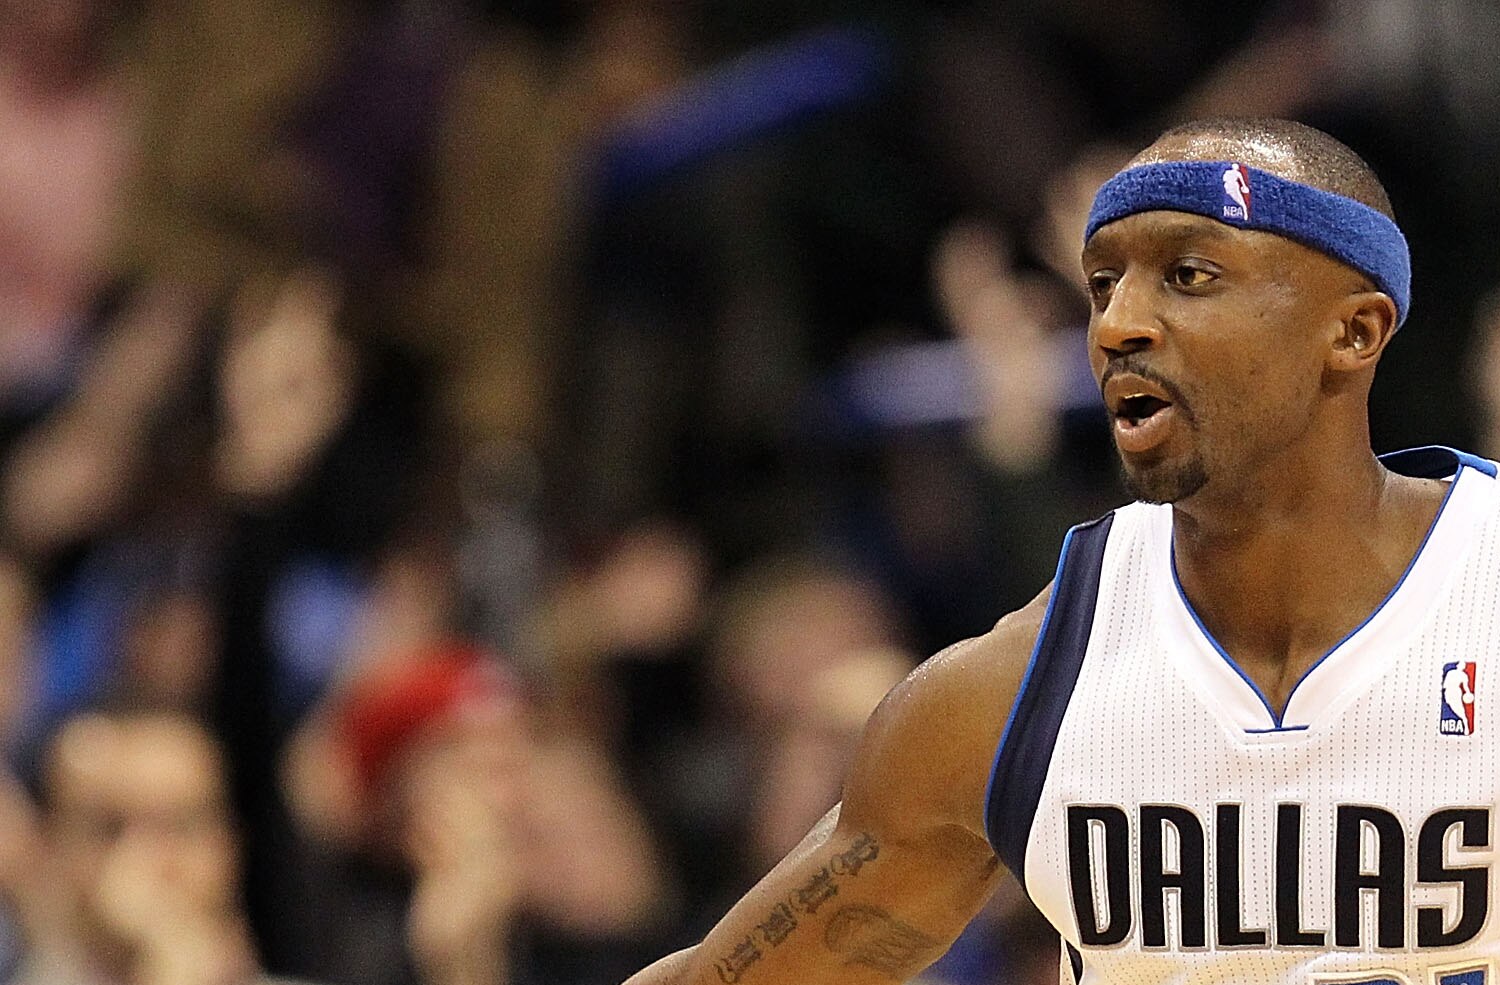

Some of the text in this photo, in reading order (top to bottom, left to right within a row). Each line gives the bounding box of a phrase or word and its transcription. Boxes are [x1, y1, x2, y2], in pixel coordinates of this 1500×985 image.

[1223, 205, 1243, 217] NBA
[1441, 719, 1464, 733] NBA
[1064, 802, 1495, 952] DALLAS
